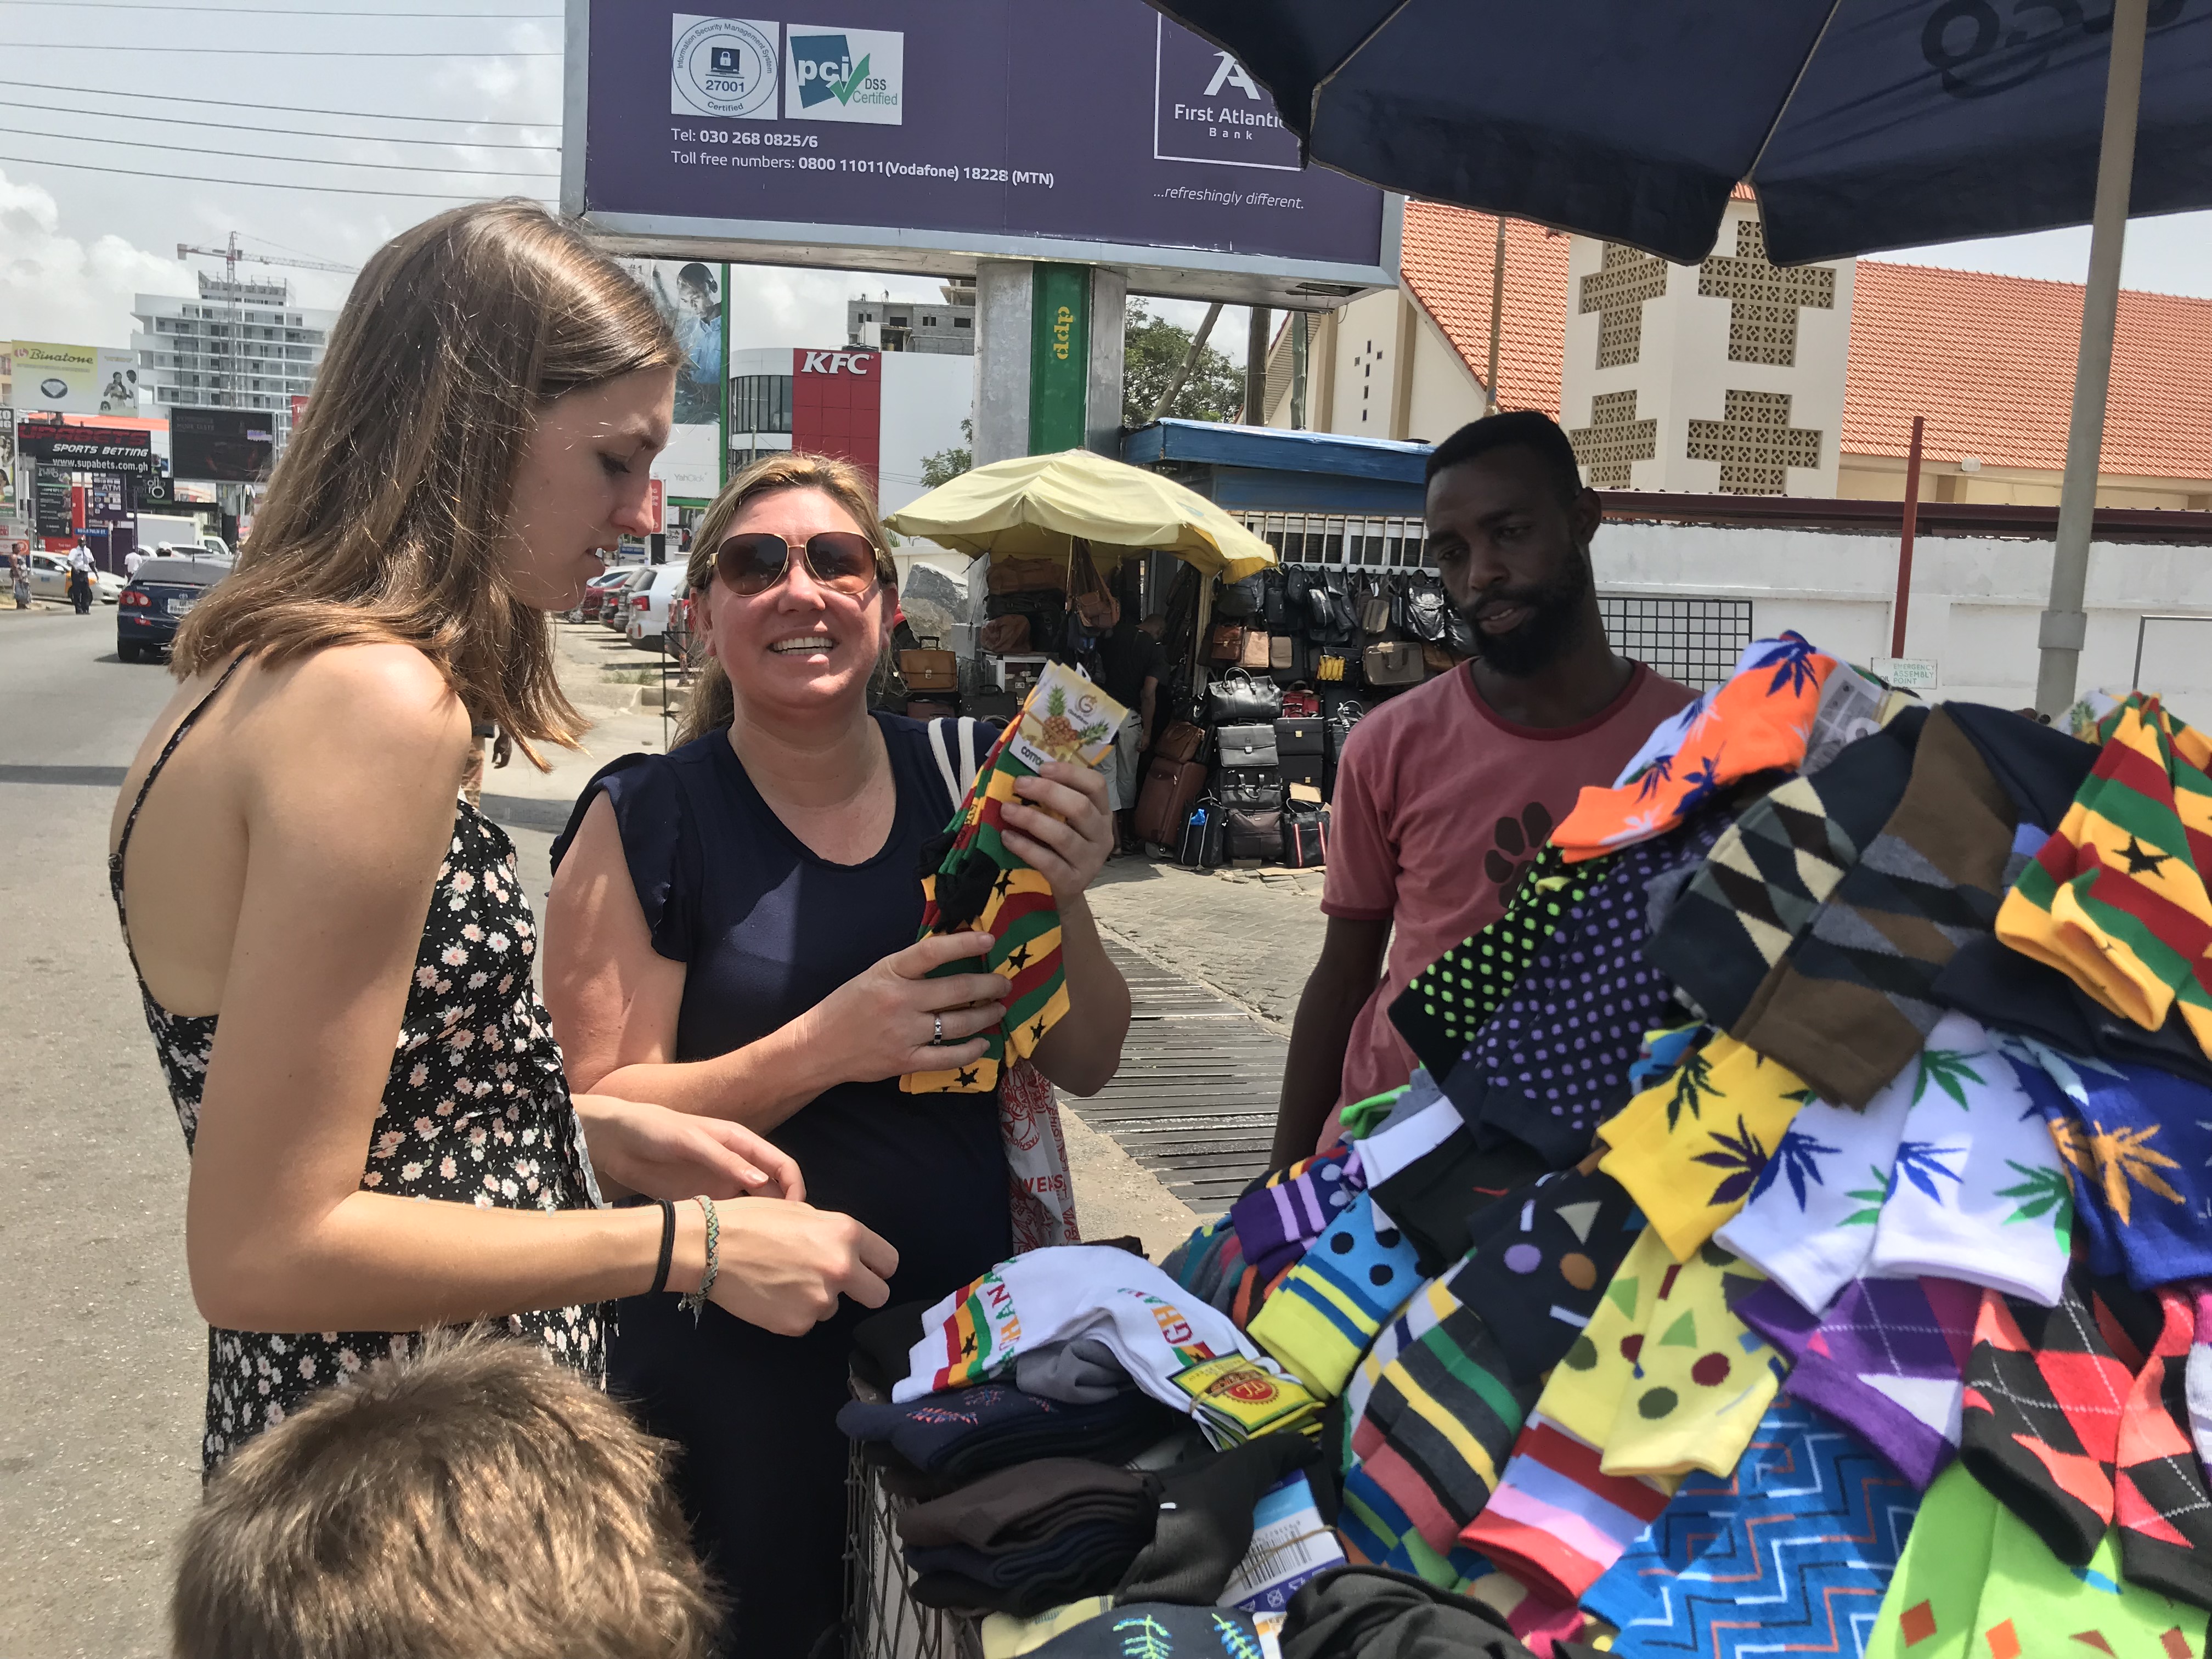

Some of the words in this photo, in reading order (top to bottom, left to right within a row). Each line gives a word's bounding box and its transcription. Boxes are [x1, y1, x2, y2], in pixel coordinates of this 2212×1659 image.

[677, 33, 697, 69] Information
[695, 23, 722, 37] Security
[724, 23, 765, 49] Management
[762, 49, 772, 74] System
[798, 56, 849, 86] pci
[706, 80, 744, 93] 27001
[865, 78, 887, 91] DSS
[707, 101, 744, 111] Certified
[853, 91, 898, 105] Certified
[1175, 104, 1214, 122] First
[670, 128, 696, 142] Tel:
[699, 130, 728, 143] 030
[732, 132, 760, 145] 268
[764, 133, 818, 148] 0825/6
[1209, 127, 1252, 140] Bank
[670, 151, 696, 164] Toll
[700, 153, 728, 166] free
[732, 155, 795, 168] numbers:
[798, 157, 836, 171] 0800
[963, 167, 1008, 182] 18228
[1012, 170, 1054, 189] (MTN)
[1153, 187, 1243, 206] ...refreshingly
[1246, 192, 1304, 209] different.
[29, 348, 94, 364] Binatone
[801, 352, 870, 375] KFC
[52, 443, 99, 454] SPORTS
[102, 446, 149, 458] BETTING
[53, 458, 148, 473] www.supabets.com.gh
[1021, 746, 1045, 766] COTTO
